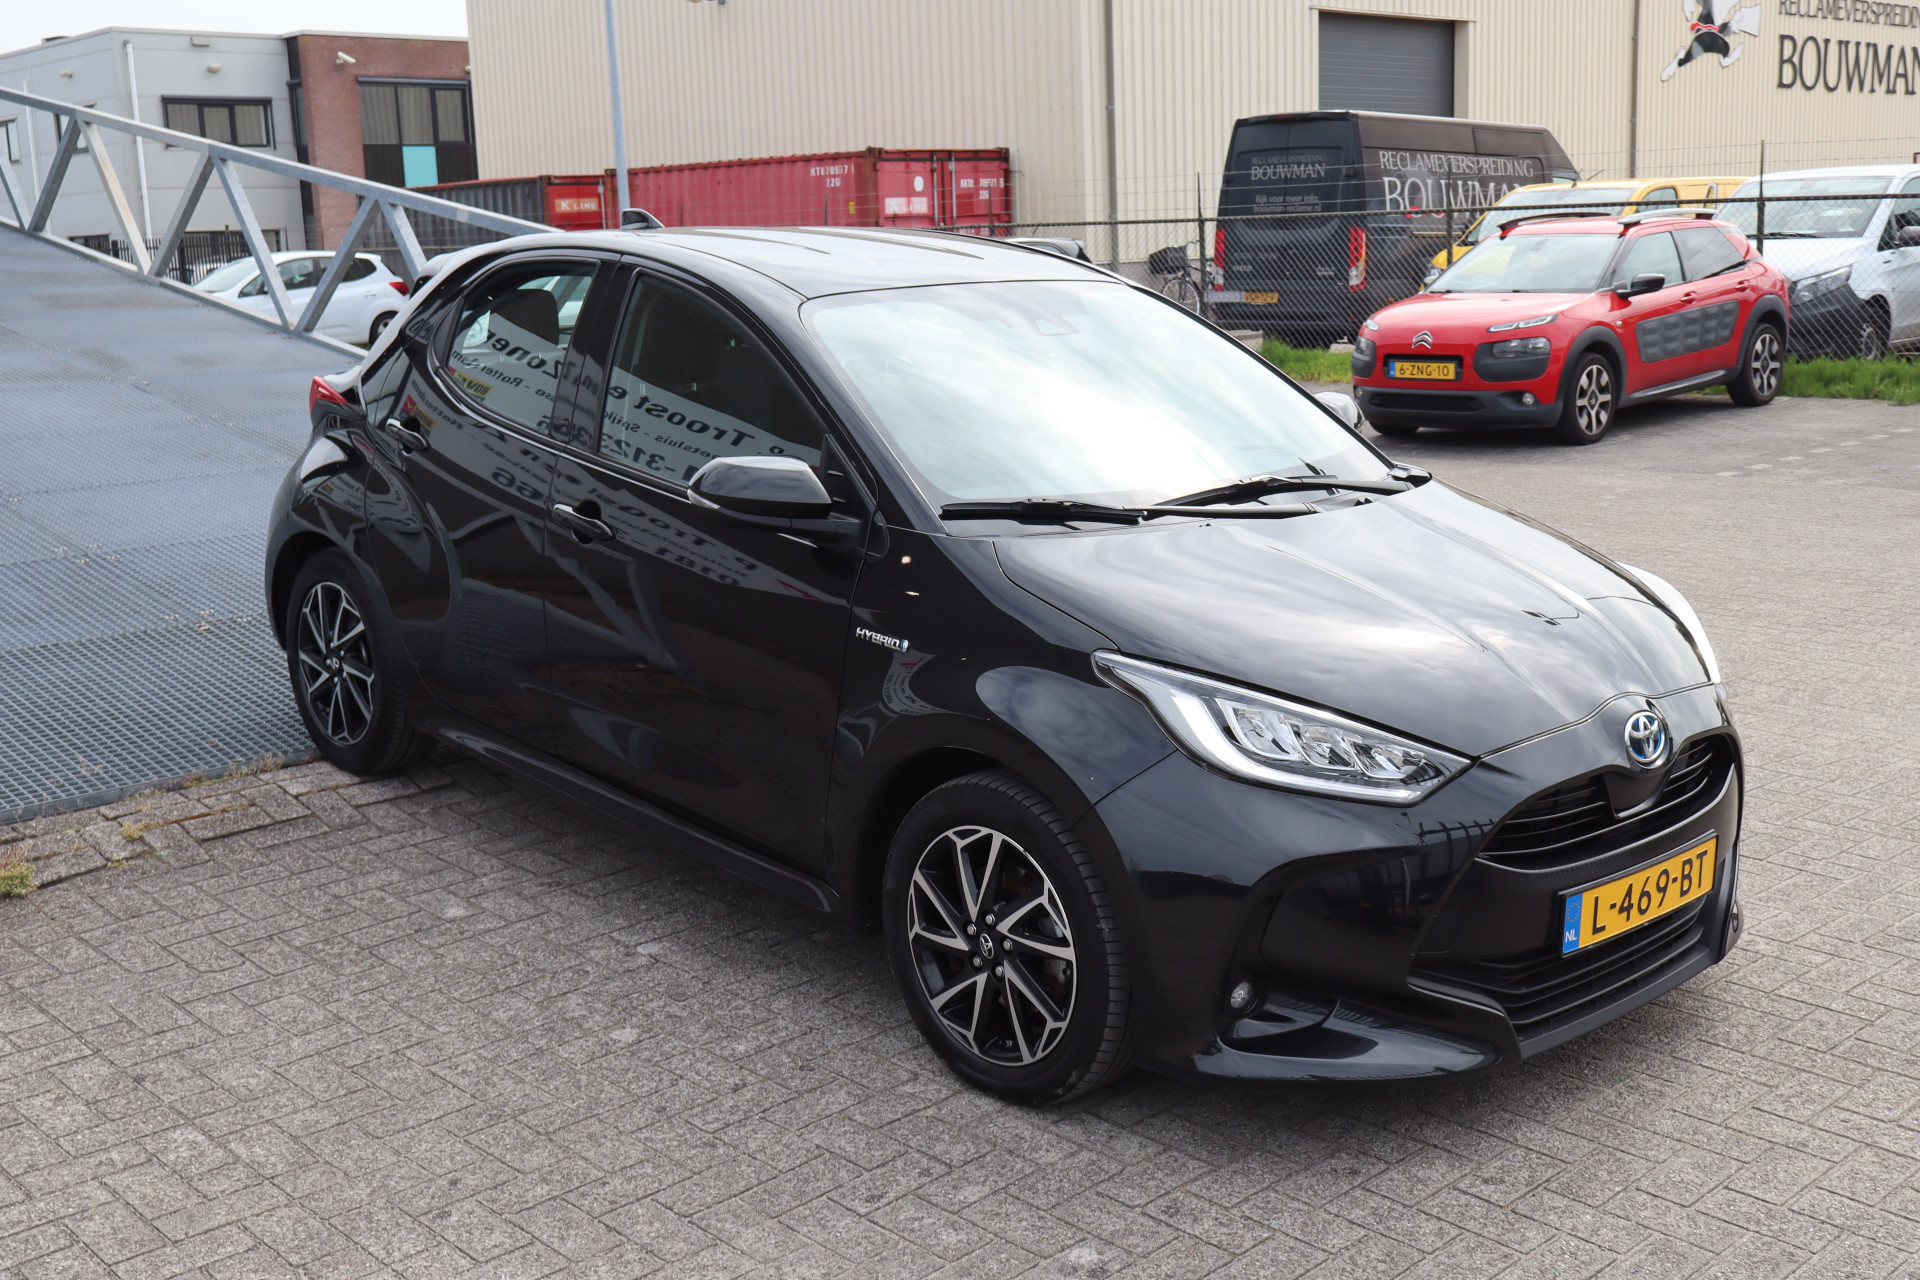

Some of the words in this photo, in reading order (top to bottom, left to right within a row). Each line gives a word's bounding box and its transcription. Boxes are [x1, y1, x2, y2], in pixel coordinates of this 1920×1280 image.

[1251, 163, 1326, 181] BOUWMAN
[573, 202, 597, 210] LINE
[1399, 364, 1450, 377] 6-ZNG-10
[856, 626, 901, 651] HYBRID
[1591, 849, 1708, 936] L-469-BT
[1565, 929, 1578, 944] NL
